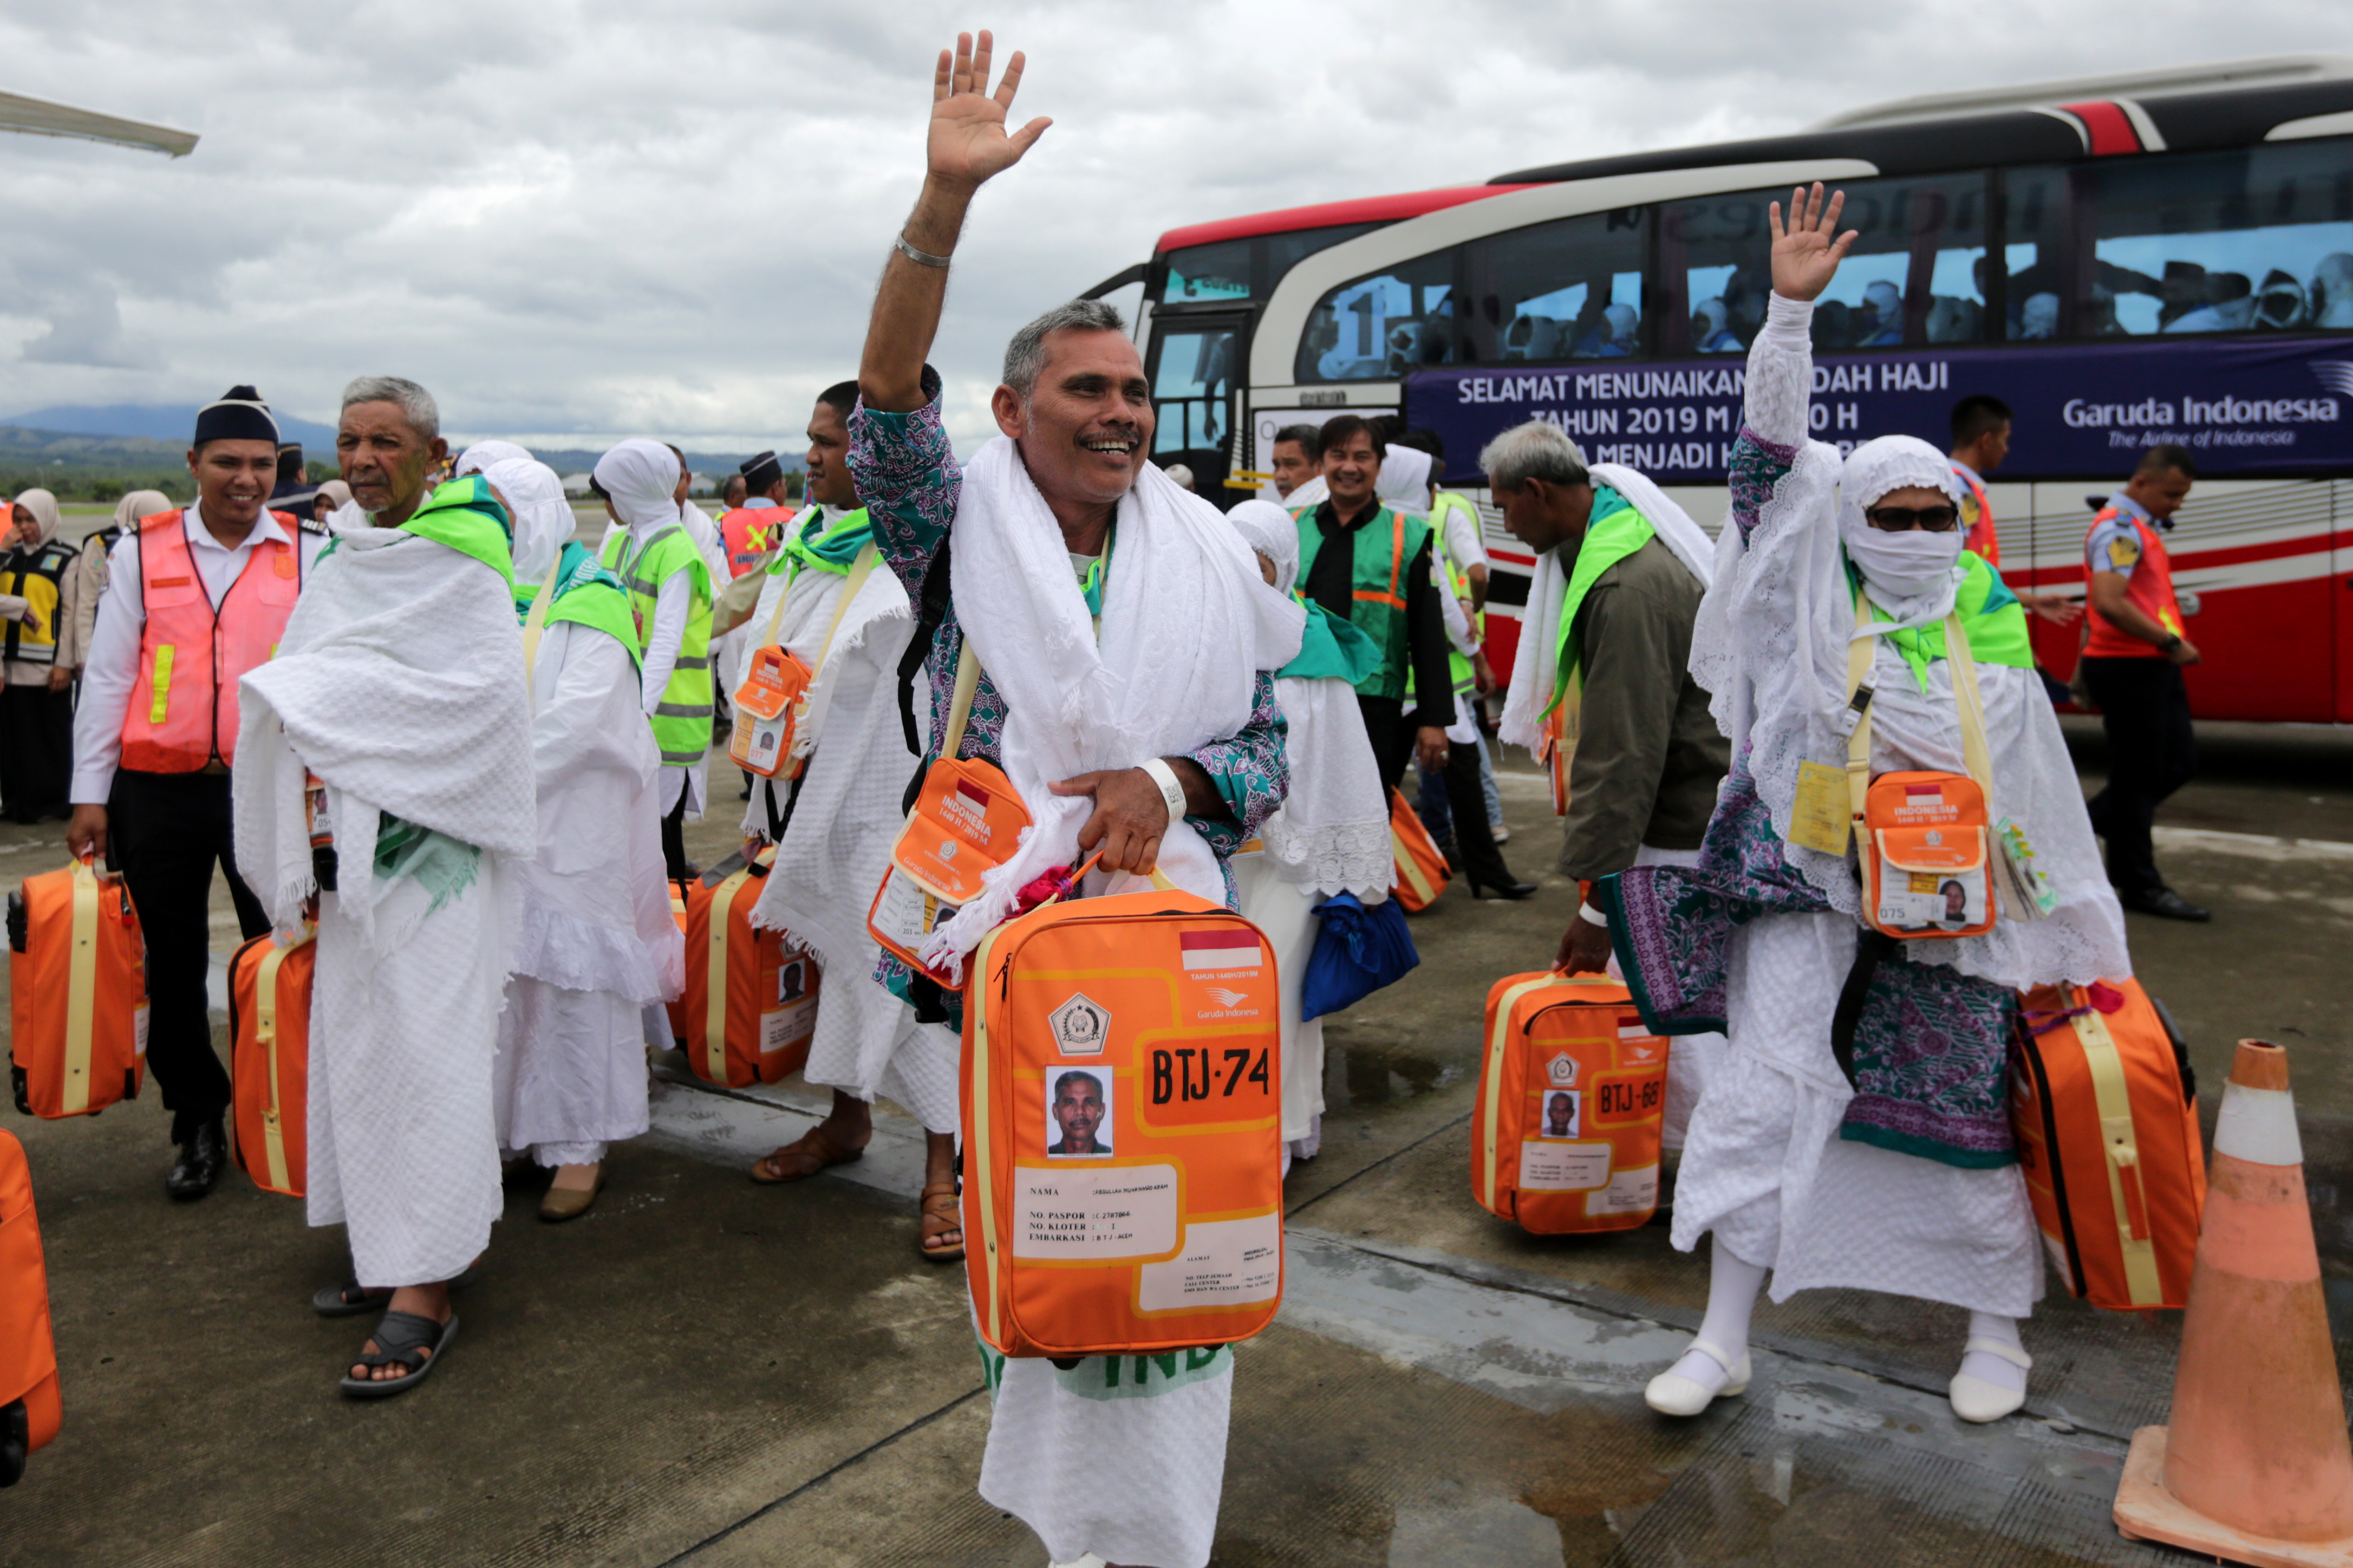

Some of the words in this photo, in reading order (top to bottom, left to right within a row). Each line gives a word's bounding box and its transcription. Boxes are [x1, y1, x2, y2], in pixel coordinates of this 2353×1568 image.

[1458, 375, 1569, 403] SELAMAT
[1811, 363, 1872, 393] DAH
[1881, 361, 1948, 392] HAJI
[1627, 406, 1698, 434] 2019
[1706, 406, 1729, 433] M
[1837, 402, 1858, 430] H
[2063, 396, 2175, 428] Garuda
[2183, 395, 2339, 425] Indonesia
[2108, 431, 2137, 448] The
[2140, 430, 2189, 448] Airline
[2193, 430, 2212, 448] of
[2213, 430, 2295, 446] Indonesia
[1597, 442, 1713, 469] MENJADI
[750, 749, 764, 759] 077
[942, 795, 991, 838] INDONESIA
[1894, 805, 1958, 816] INDONESIA
[939, 807, 955, 822] 1440
[955, 817, 962, 827] H
[964, 824, 979, 839] 2019
[979, 835, 988, 845] M
[904, 856, 925, 876] Garuda
[924, 870, 951, 892] Indonesia
[1880, 908, 1905, 918] 075
[1217, 971, 1258, 980] 1440H/2019M
[1198, 1010, 1224, 1019] Garuda
[1225, 1009, 1258, 1017] Indonesia
[1030, 1187, 1059, 1196] NAMA
[1030, 1233, 1085, 1242] EMBARKASI
